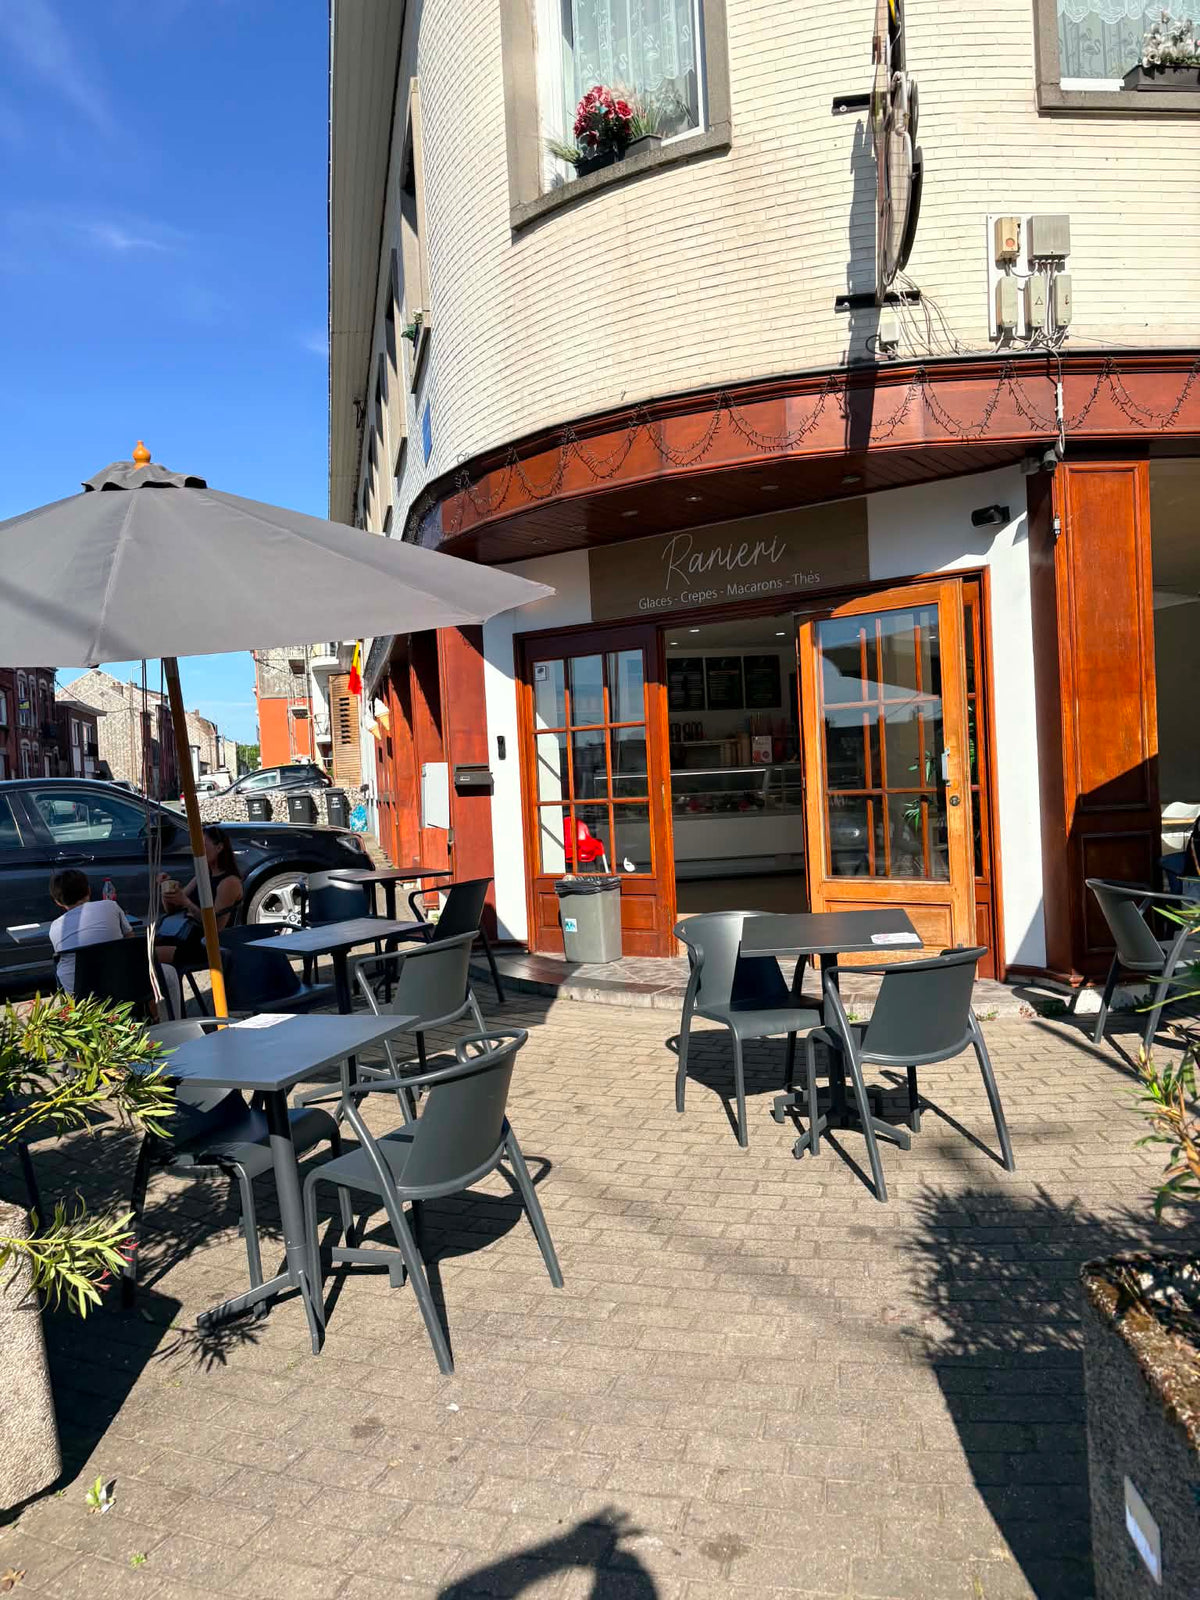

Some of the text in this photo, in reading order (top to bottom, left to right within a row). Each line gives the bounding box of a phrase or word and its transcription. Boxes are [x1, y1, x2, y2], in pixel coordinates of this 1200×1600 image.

[661, 533, 786, 591] Ranieri
[638, 596, 673, 610] Glaces
[727, 579, 783, 596] Macarons
